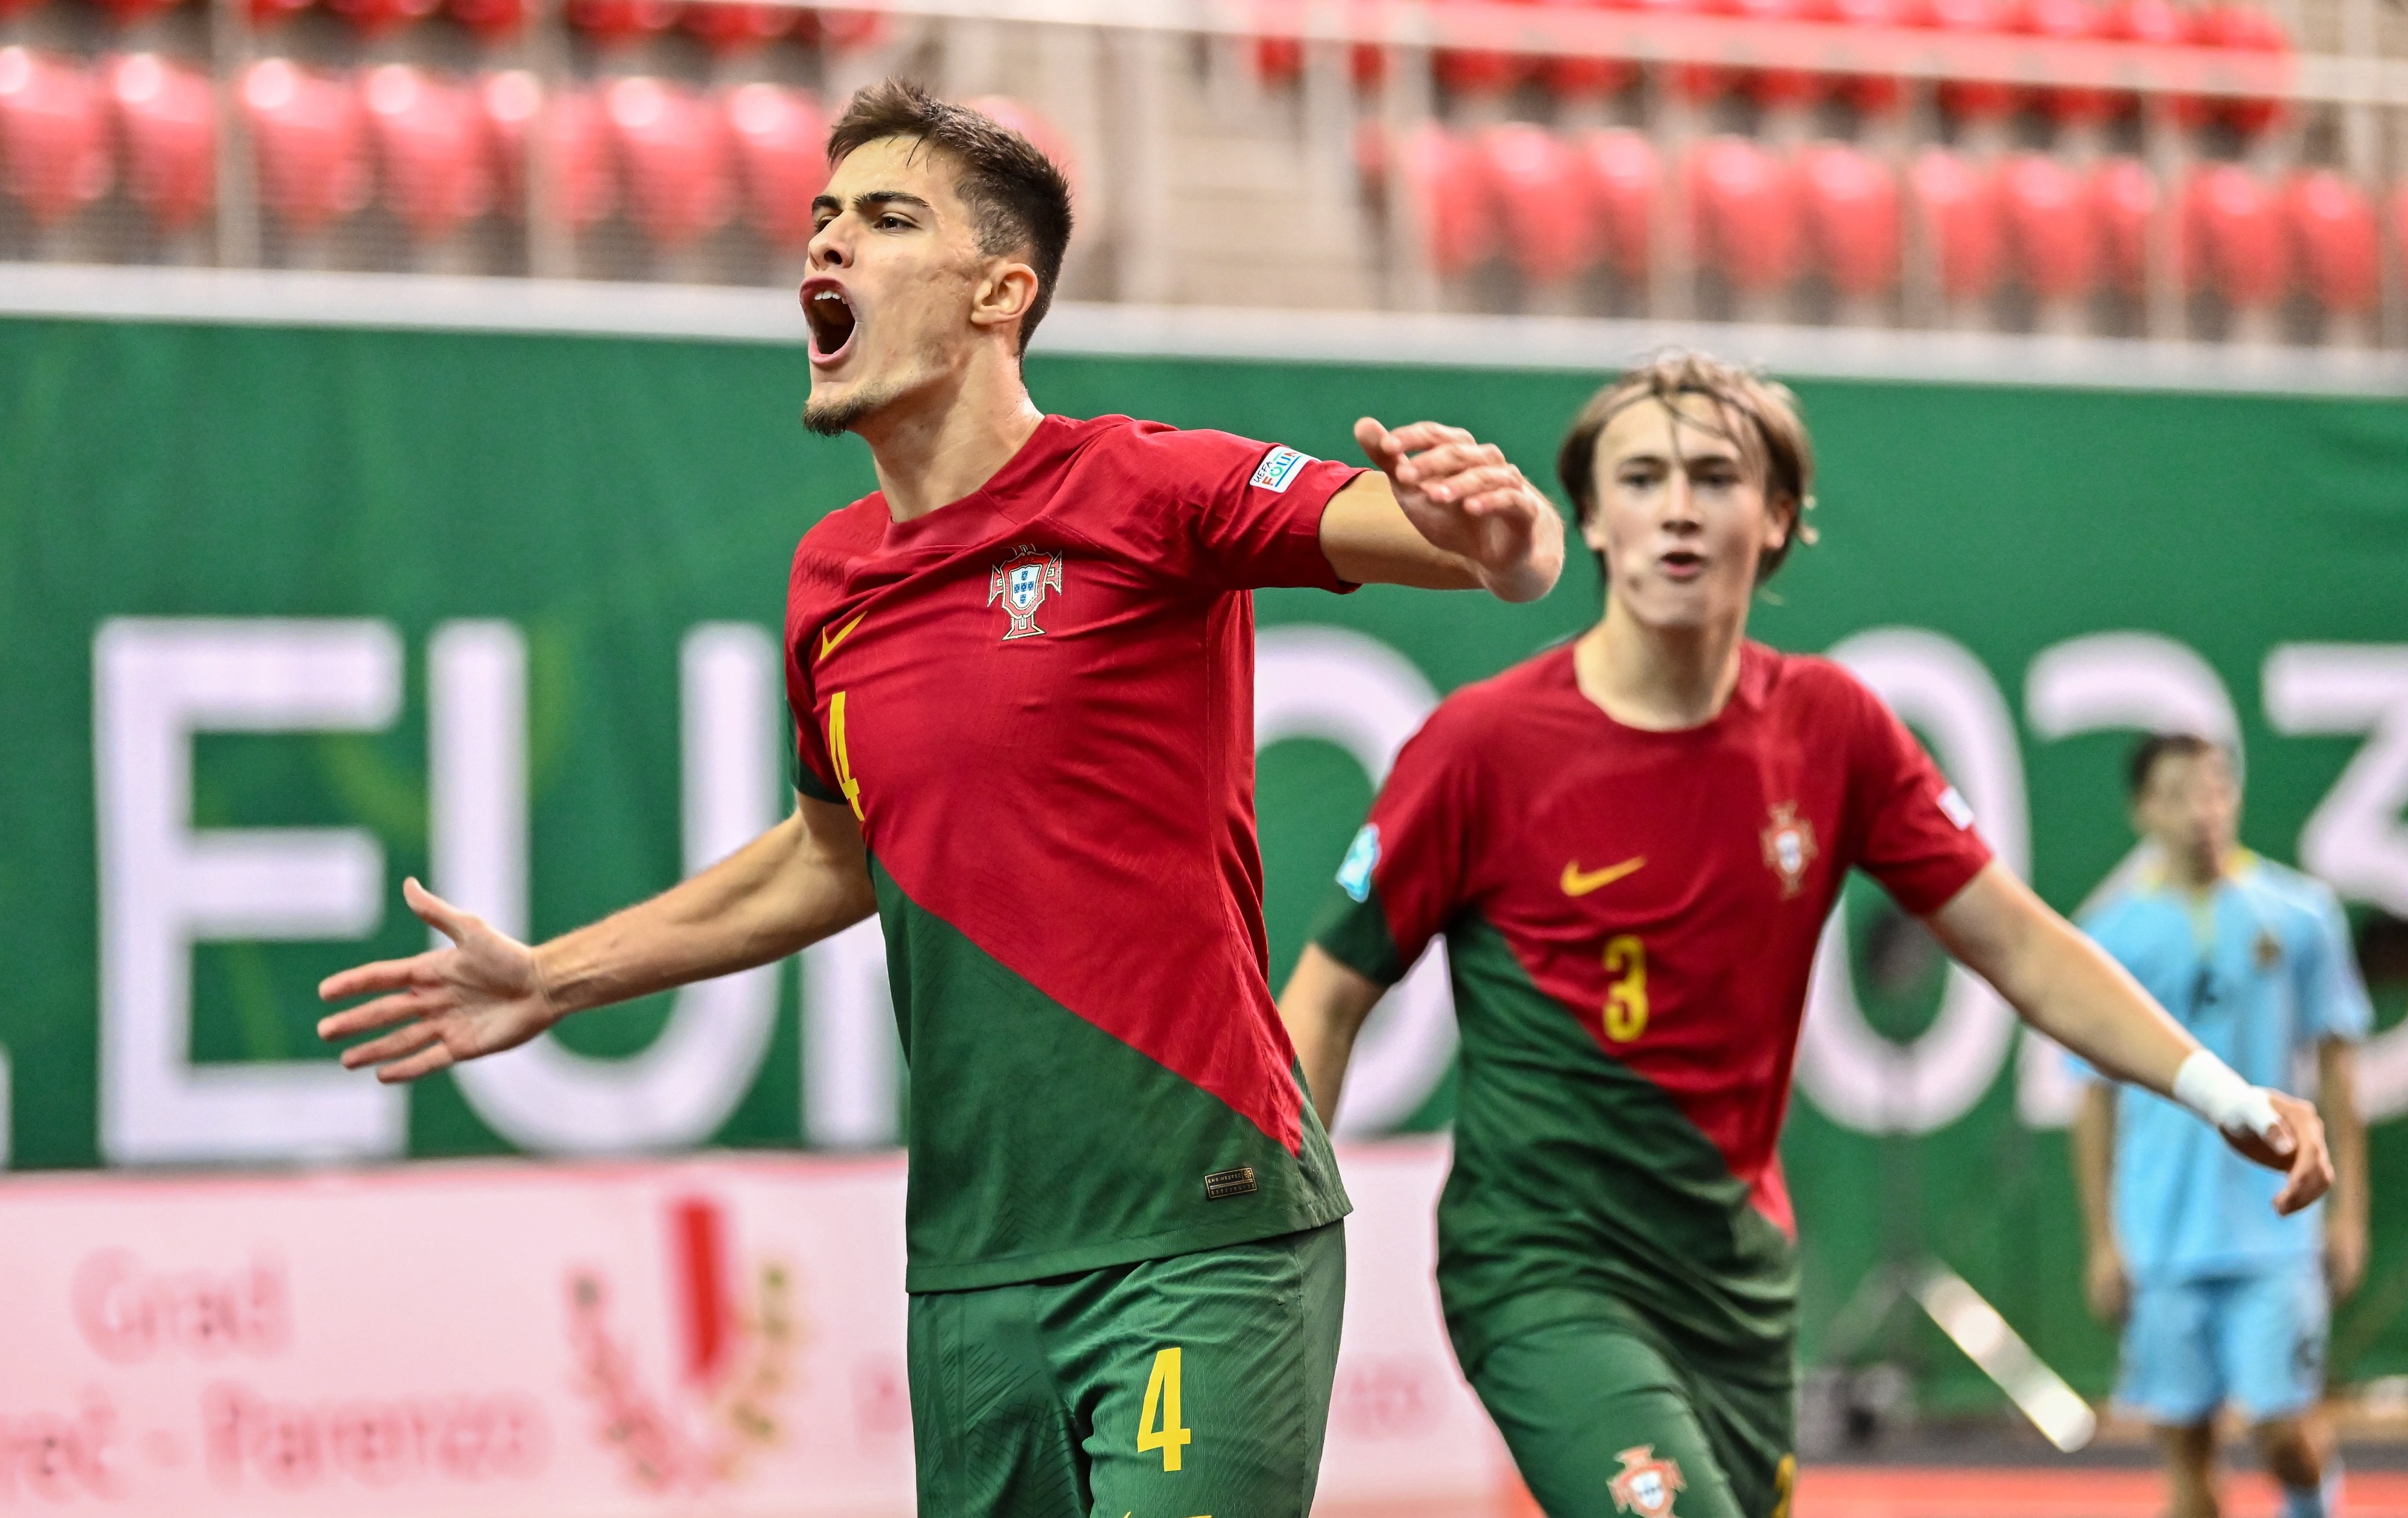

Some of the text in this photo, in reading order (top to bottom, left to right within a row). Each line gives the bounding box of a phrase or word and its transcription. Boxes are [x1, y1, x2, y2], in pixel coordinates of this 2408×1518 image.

[1253, 461, 1273, 482] UEFA
[830, 691, 864, 821] 4
[93, 614, 1460, 1162] EUO
[1603, 935, 1649, 1043] 3
[72, 1251, 289, 1364] Grad
[203, 1380, 551, 1493] Parenzo
[1137, 1348, 1191, 1472] 4
